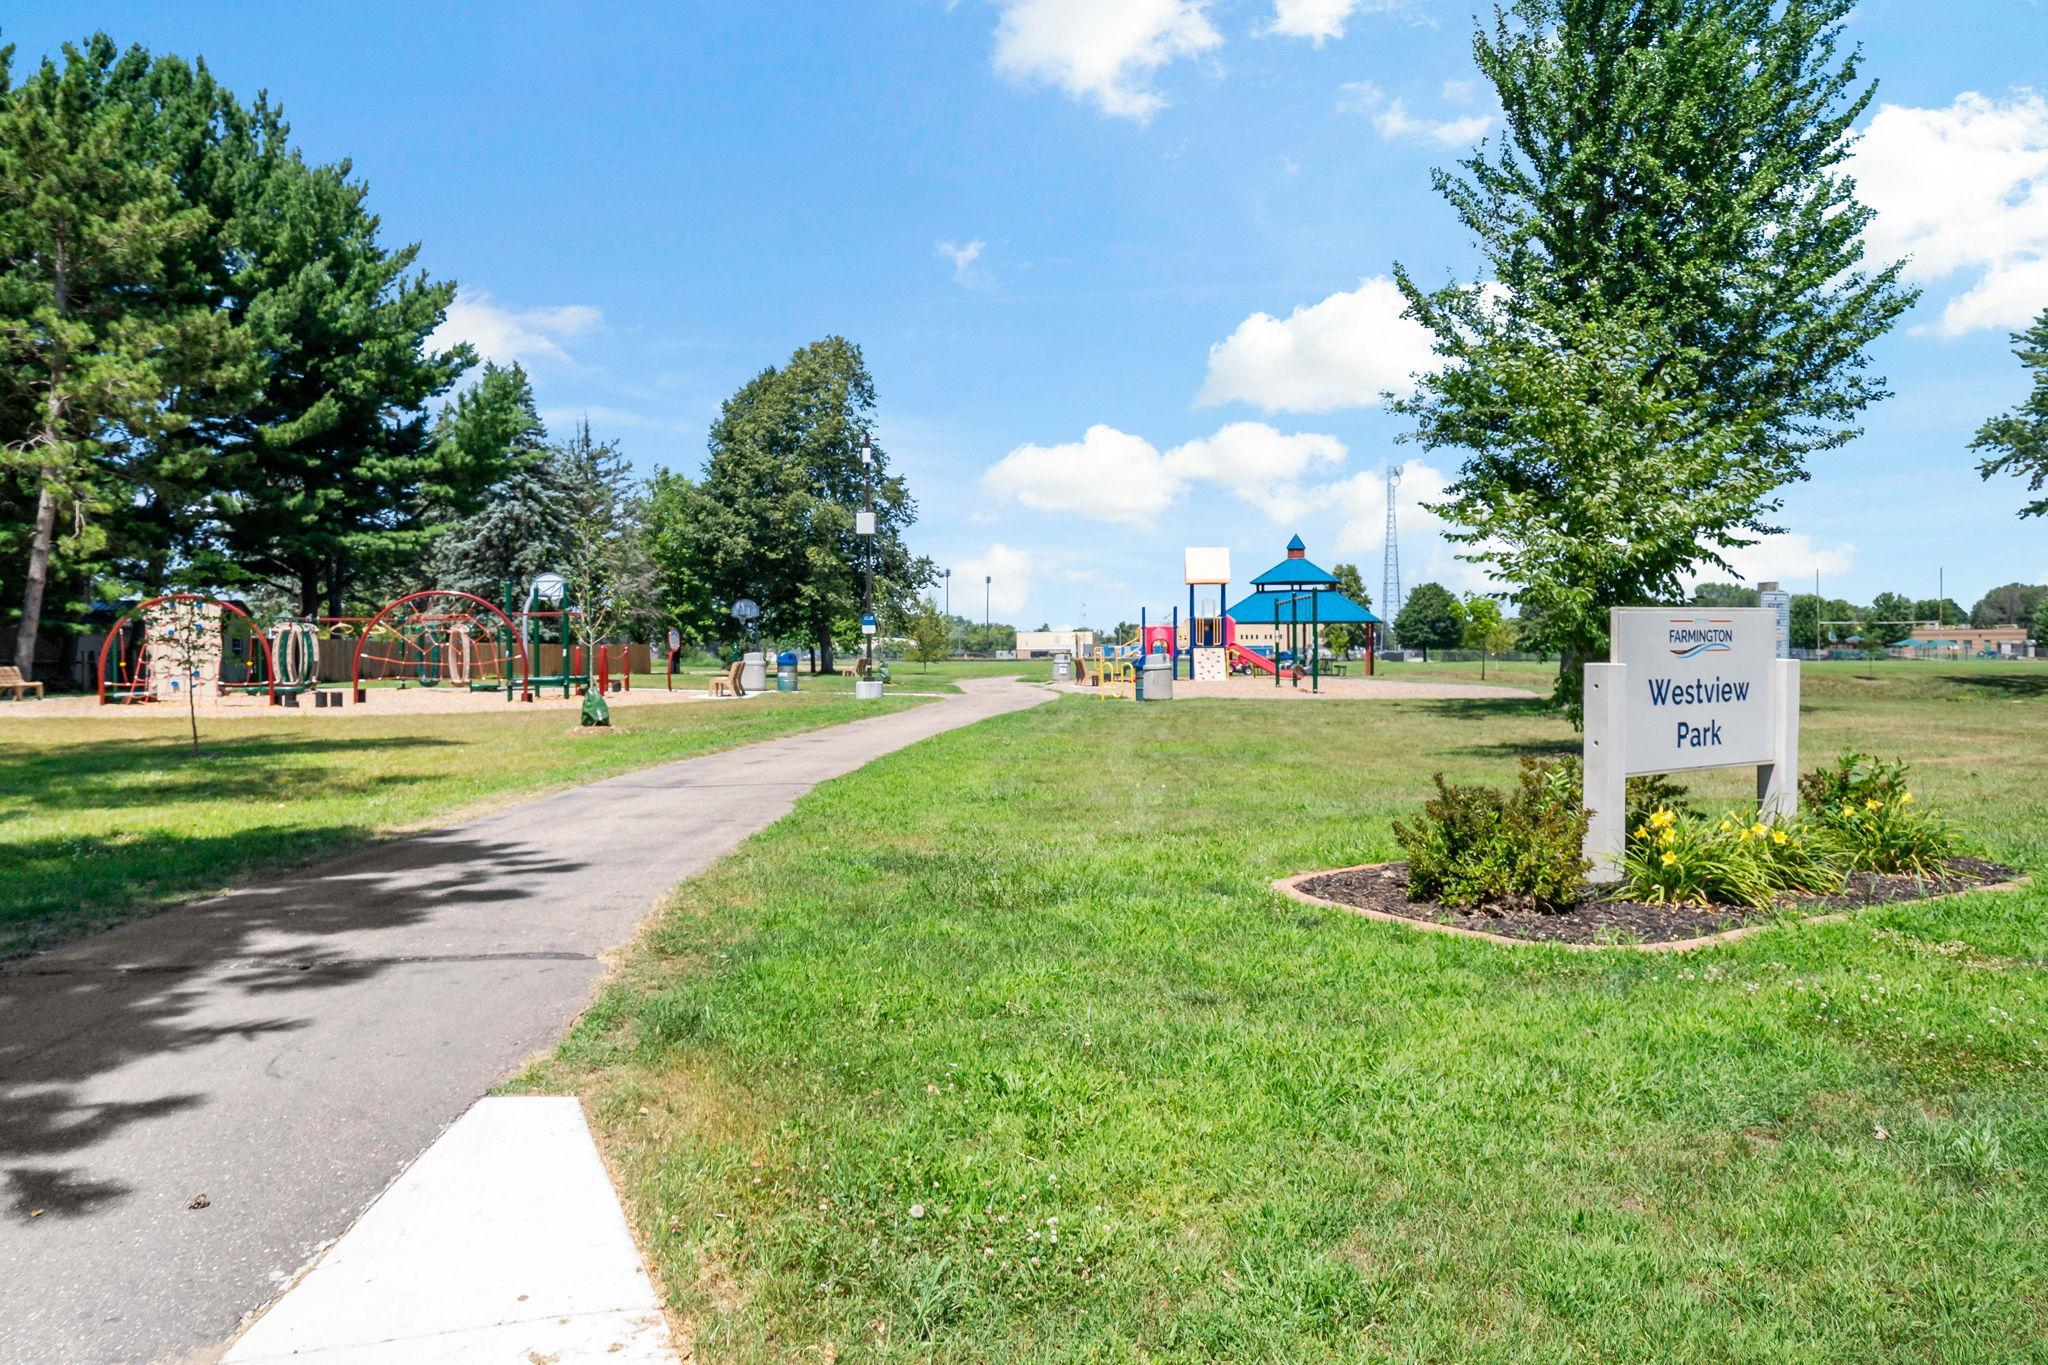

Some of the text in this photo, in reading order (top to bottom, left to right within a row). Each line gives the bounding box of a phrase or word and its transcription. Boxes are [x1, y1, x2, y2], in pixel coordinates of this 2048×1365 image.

[1669, 629, 1733, 643] FARMINGTON
[1648, 677, 1750, 706] Westview
[1677, 719, 1722, 748] Park
